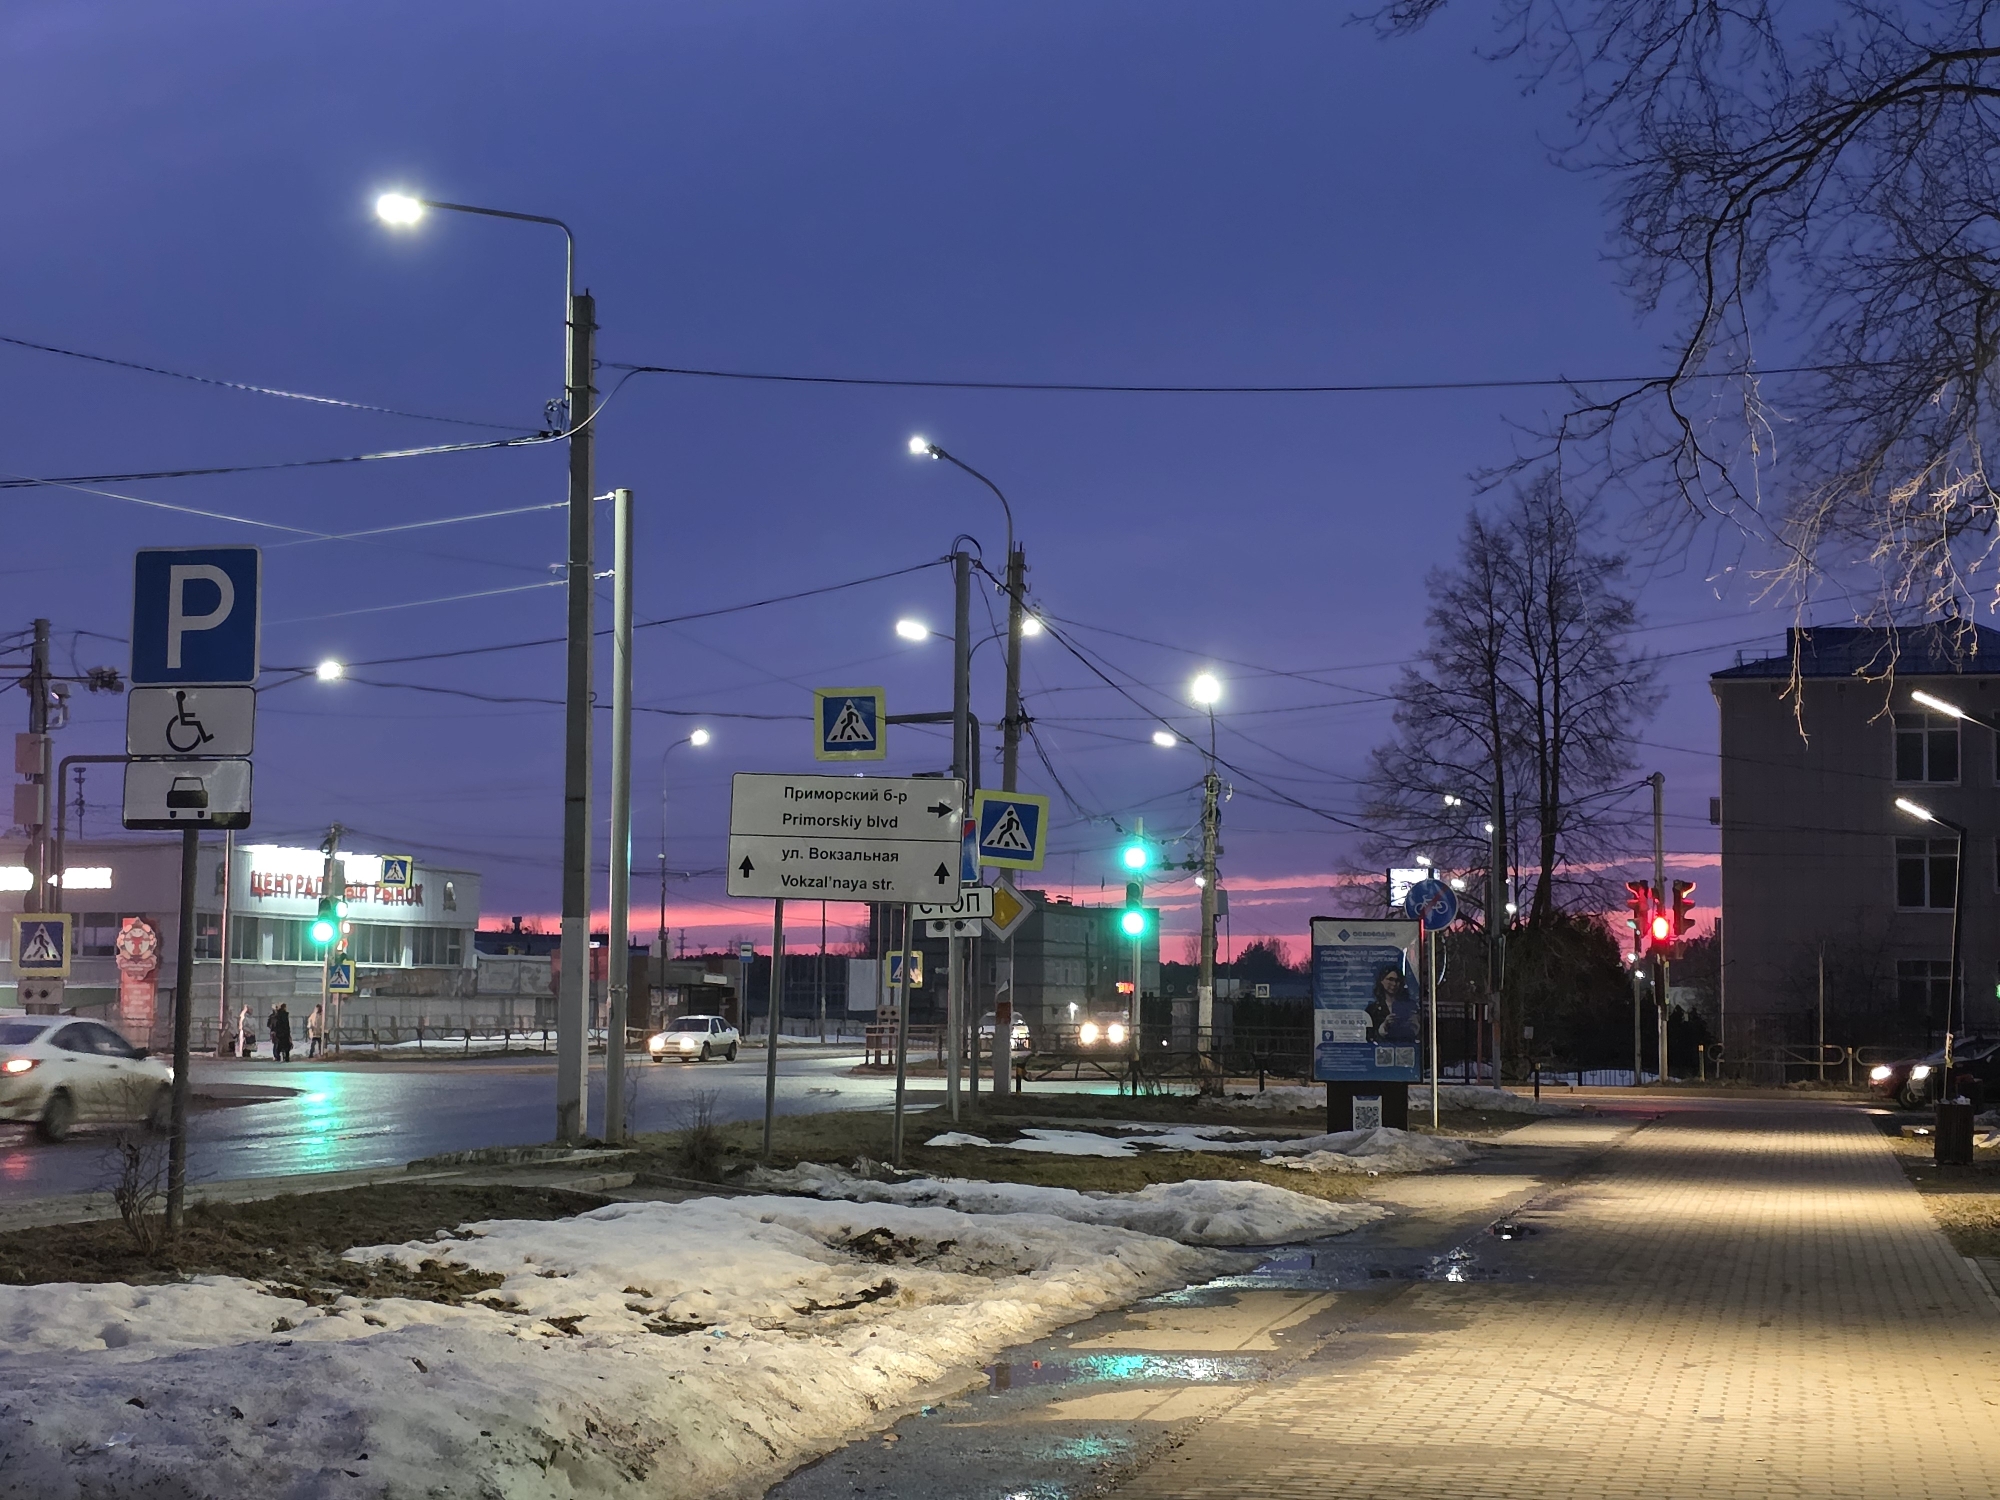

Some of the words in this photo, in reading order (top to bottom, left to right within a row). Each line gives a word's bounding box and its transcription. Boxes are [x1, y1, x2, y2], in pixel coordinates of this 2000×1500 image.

[166, 564, 235, 669] P
[784, 786, 879, 803] Приморский
[883, 789, 907, 805] б-р
[782, 813, 862, 830] Primorskiy
[867, 815, 898, 828] blvd
[781, 849, 803, 861] ул.
[809, 847, 899, 862] Вокзальная
[250, 870, 368, 903] ЦЕНТРАЛЫЙ
[374, 883, 424, 907] РЫНОК
[872, 879, 895, 890] str.
